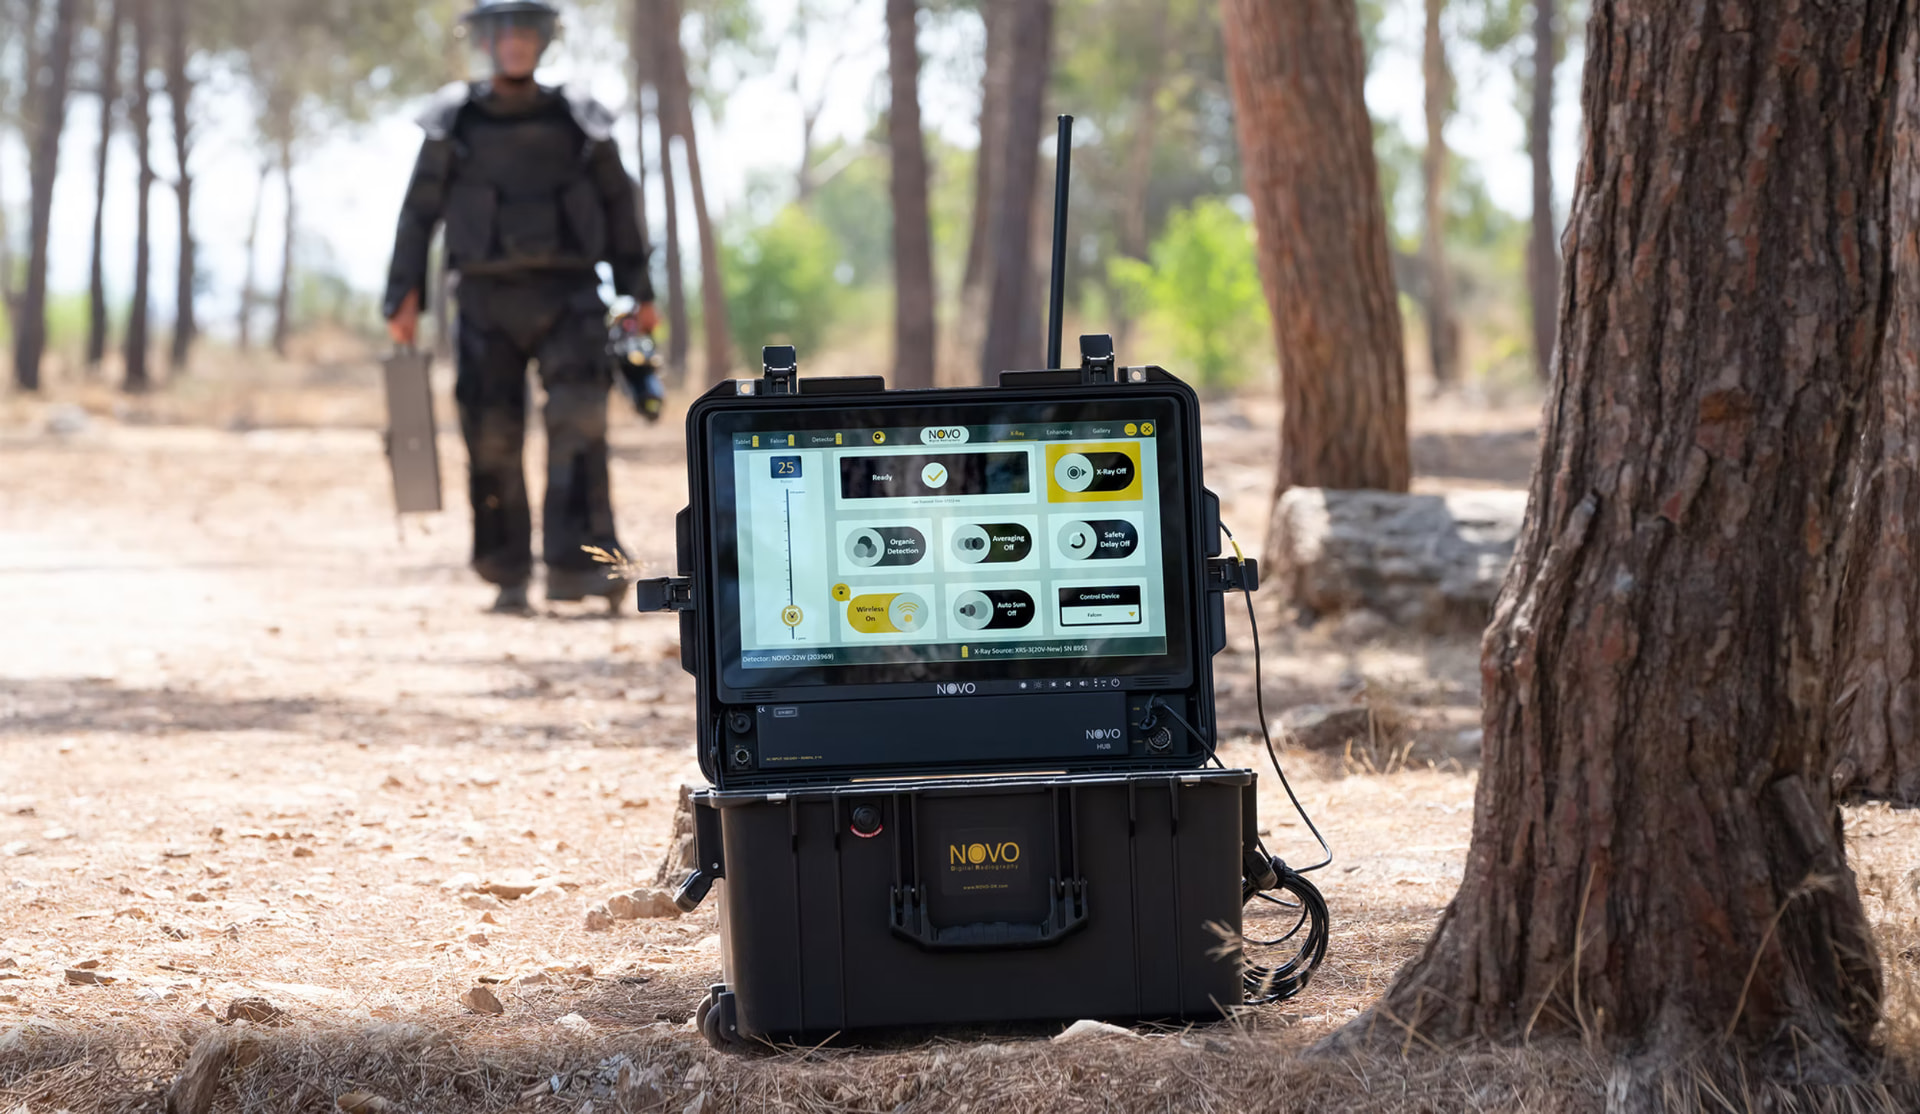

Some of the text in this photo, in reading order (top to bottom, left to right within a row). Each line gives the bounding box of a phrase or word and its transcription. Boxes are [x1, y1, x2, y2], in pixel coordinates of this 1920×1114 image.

[929, 428, 961, 439] NOVO
[1046, 428, 1073, 436] Enhancing
[778, 462, 795, 474] 25
[1096, 467, 1127, 476] X-Ray Off
[872, 474, 893, 482] Ready
[992, 534, 1025, 543] Averaging
[1104, 531, 1125, 539] Safety
[890, 538, 916, 546] Organic
[1100, 541, 1119, 549] Delay
[887, 547, 919, 555] Detection
[1003, 543, 1015, 551] Off
[856, 605, 884, 613] Wireless
[1007, 609, 1017, 617] Off
[807, 653, 834, 661] (203969)
[936, 682, 976, 695] NOVO
[1086, 728, 1121, 740] NOVO
[950, 841, 1020, 864] NOVO
